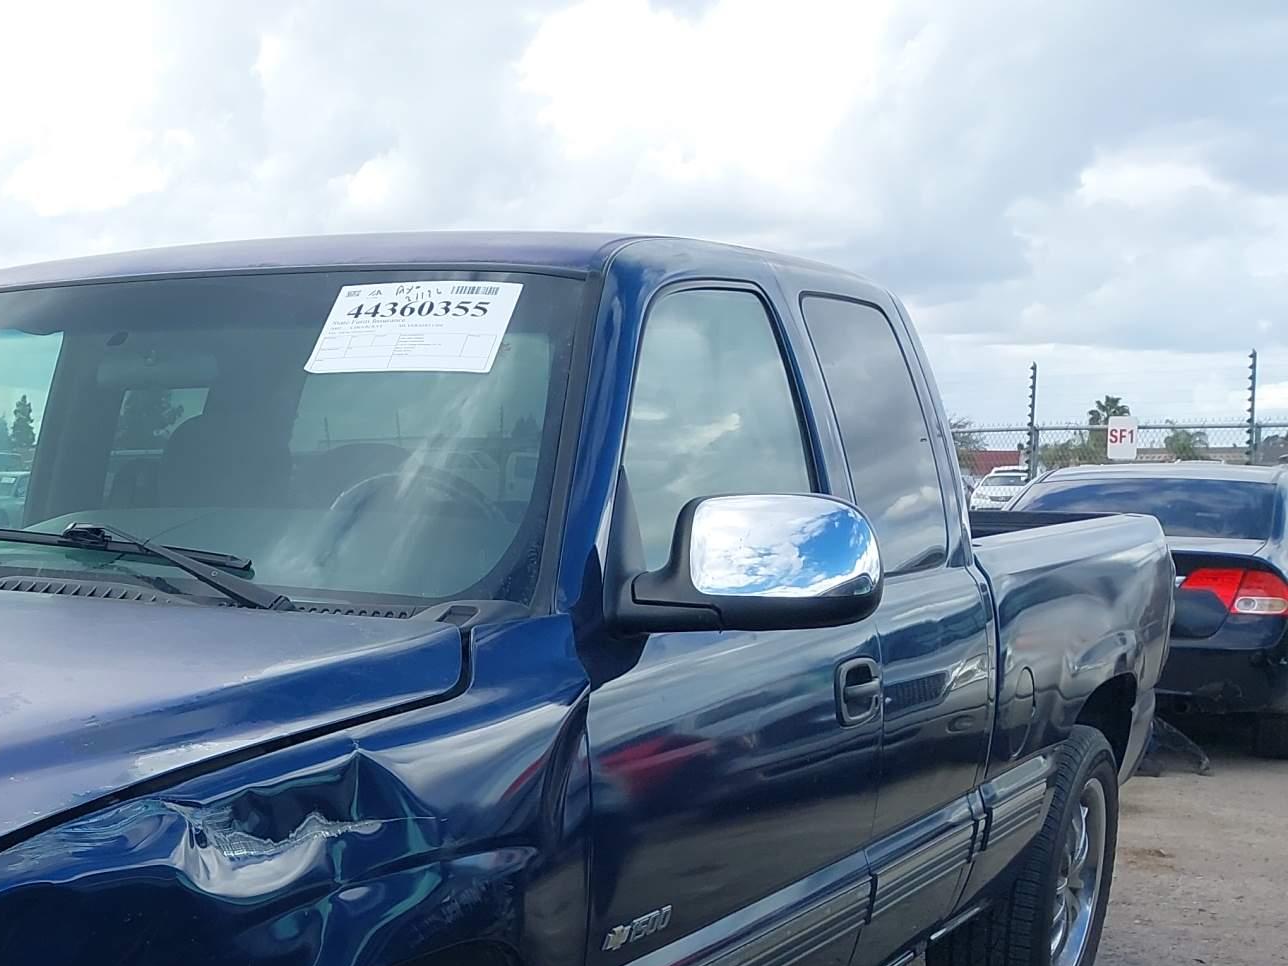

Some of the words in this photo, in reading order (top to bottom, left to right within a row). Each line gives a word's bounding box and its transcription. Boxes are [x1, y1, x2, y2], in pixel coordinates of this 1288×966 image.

[346, 301, 490, 318] 44360355
[1109, 428, 1134, 444] SF1
[630, 905, 672, 942] 1500
